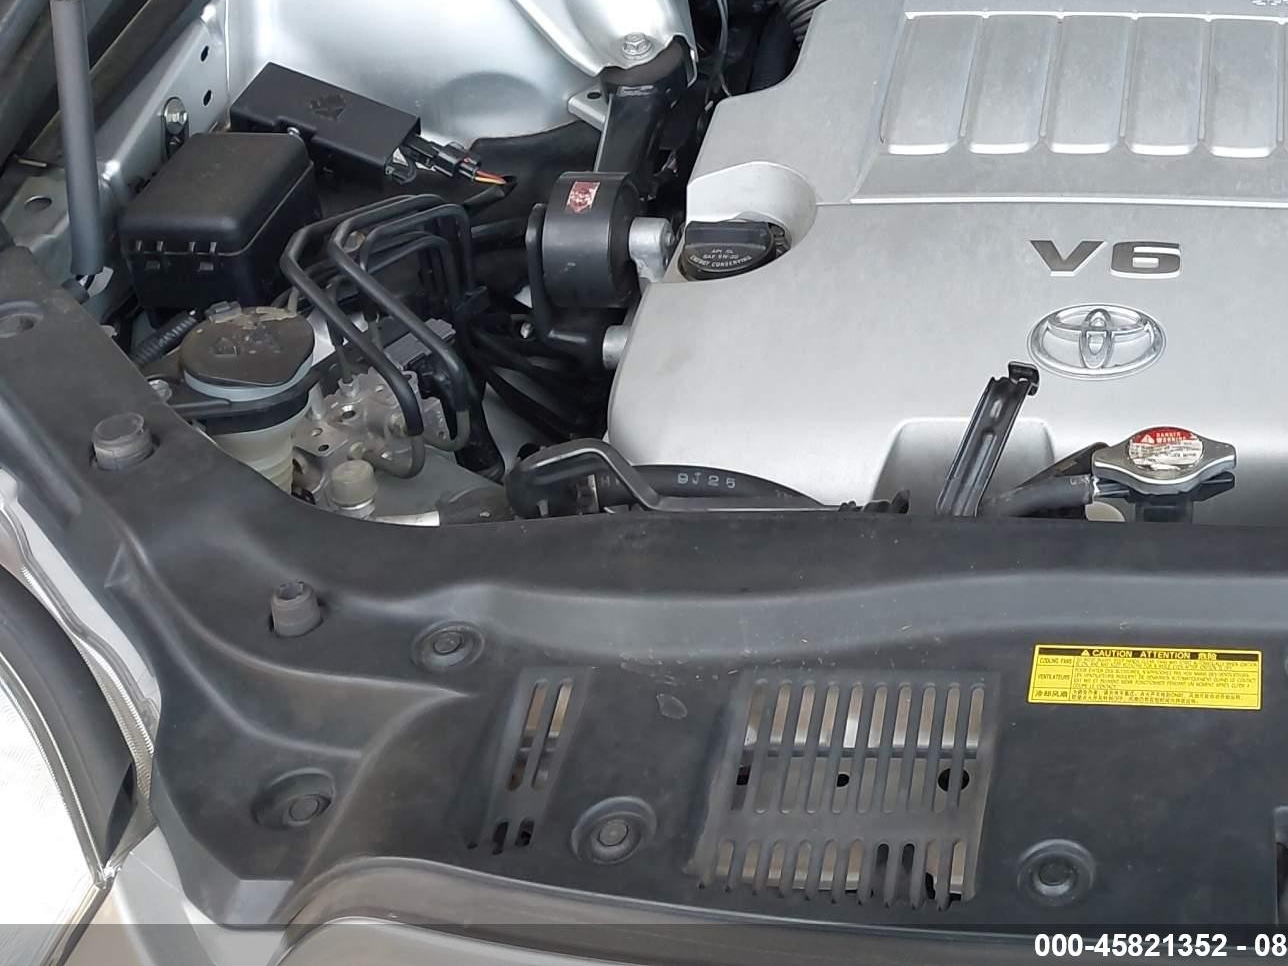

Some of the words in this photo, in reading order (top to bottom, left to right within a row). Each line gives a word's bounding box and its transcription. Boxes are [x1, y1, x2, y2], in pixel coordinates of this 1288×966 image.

[1029, 240, 1181, 279] V6
[1092, 649, 1132, 658] CAUTION
[1140, 650, 1191, 659] ATTENTION
